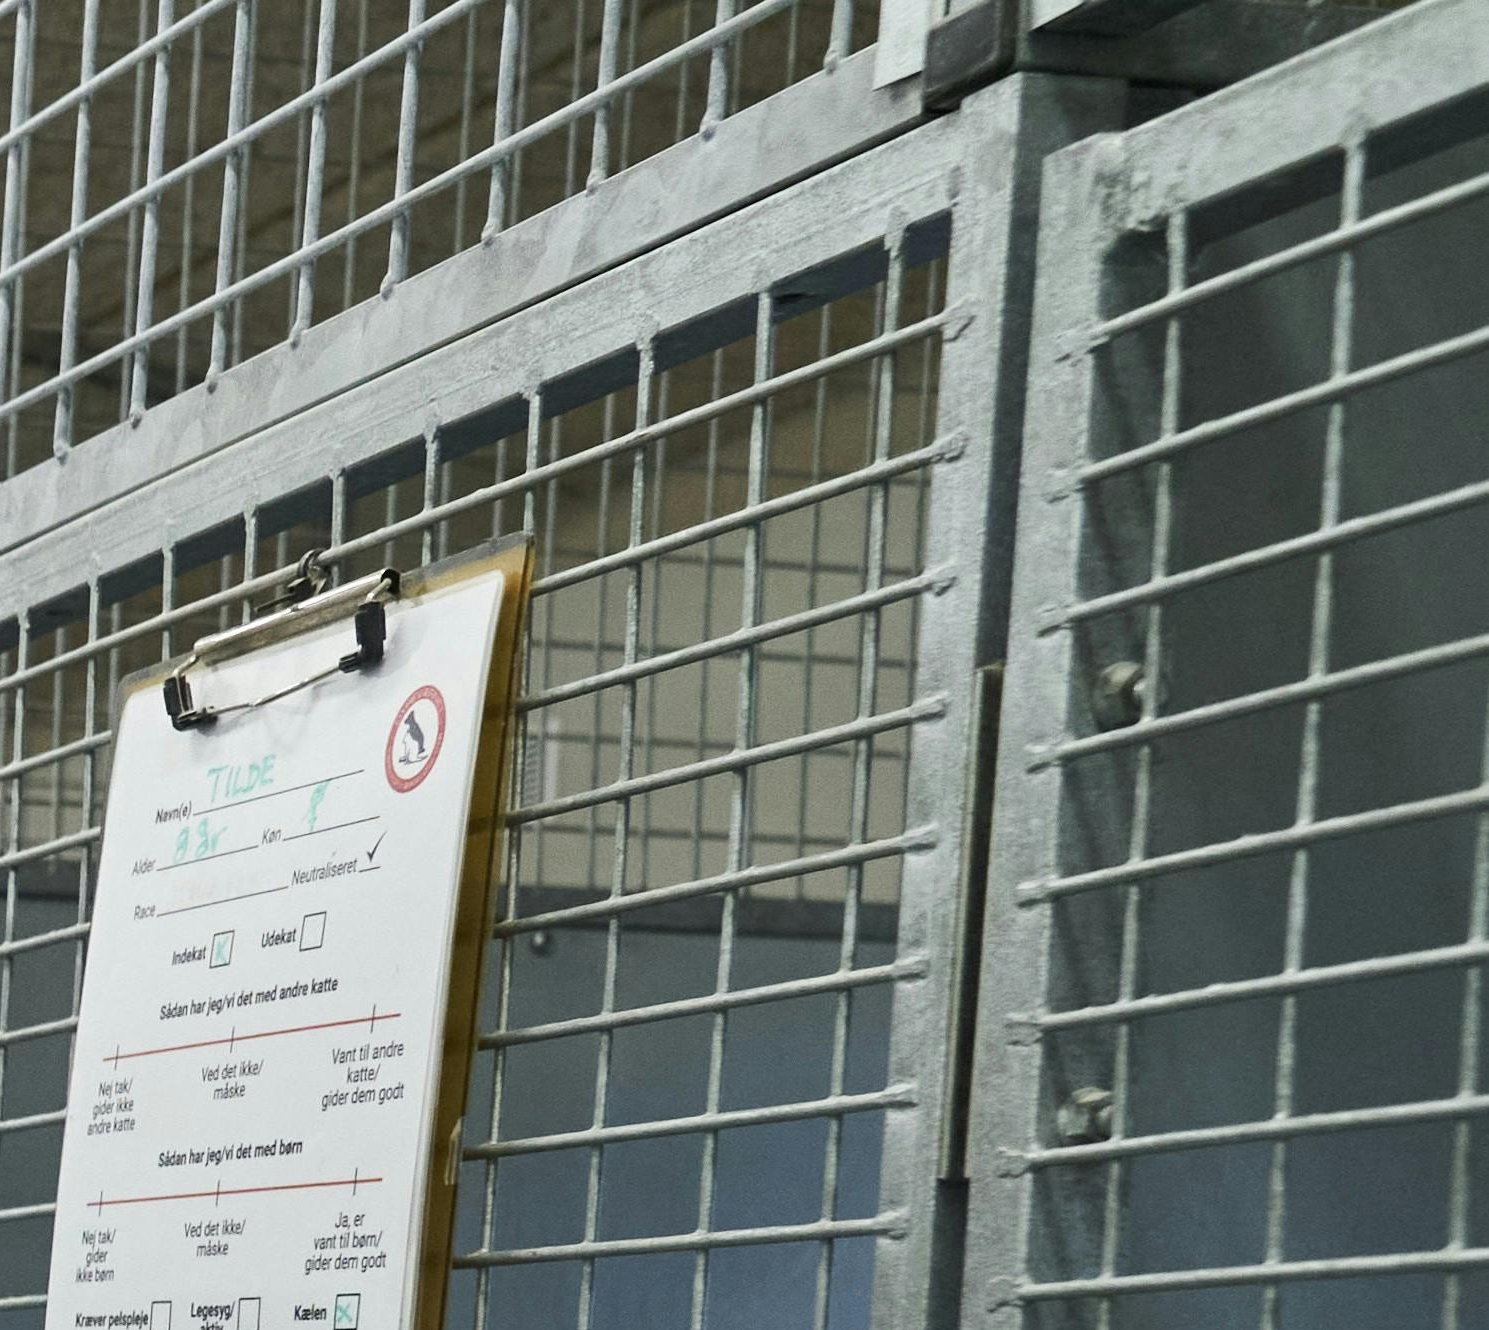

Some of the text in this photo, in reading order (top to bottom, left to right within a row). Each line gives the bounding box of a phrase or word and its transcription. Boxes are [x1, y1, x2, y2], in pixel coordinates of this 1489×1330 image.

[207, 753, 276, 802] TILDE
[155, 801, 192, 824] Navn(e)
[262, 828, 282, 845] Køn
[132, 859, 156, 875] Alder
[291, 858, 358, 886] Neutraliseret
[134, 904, 156, 920] Race
[261, 928, 297, 948] Udekat
[172, 946, 206, 966] Indekat
[159, 976, 338, 1020] Sådan har jeg/vi det med andre katte
[332, 1041, 404, 1064] Vant til andre
[202, 1060, 264, 1082] Ved det ikke/
[347, 1065, 381, 1084] katte/
[98, 1078, 133, 1098] Nej tak/
[213, 1084, 245, 1100] måske
[321, 1082, 404, 1112] gider dem godt
[92, 1099, 134, 1120] gider ikke
[87, 1118, 135, 1136] andre katte
[158, 1139, 303, 1167] Sådan har jeg/vi det med børn
[184, 1219, 246, 1238] Ved det ikke/
[335, 1212, 365, 1229] Ja, er
[82, 1228, 116, 1248] Nej tak/
[314, 1230, 383, 1250] vant til børn/
[85, 1250, 108, 1267] gider
[196, 1241, 229, 1257] måske
[305, 1252, 386, 1275] gider dem godt
[76, 1269, 114, 1283] ikke børn
[75, 1310, 149, 1330] Kræver pelspleje
[190, 1301, 235, 1321] Legesyg/
[294, 1304, 327, 1321] Kælen
